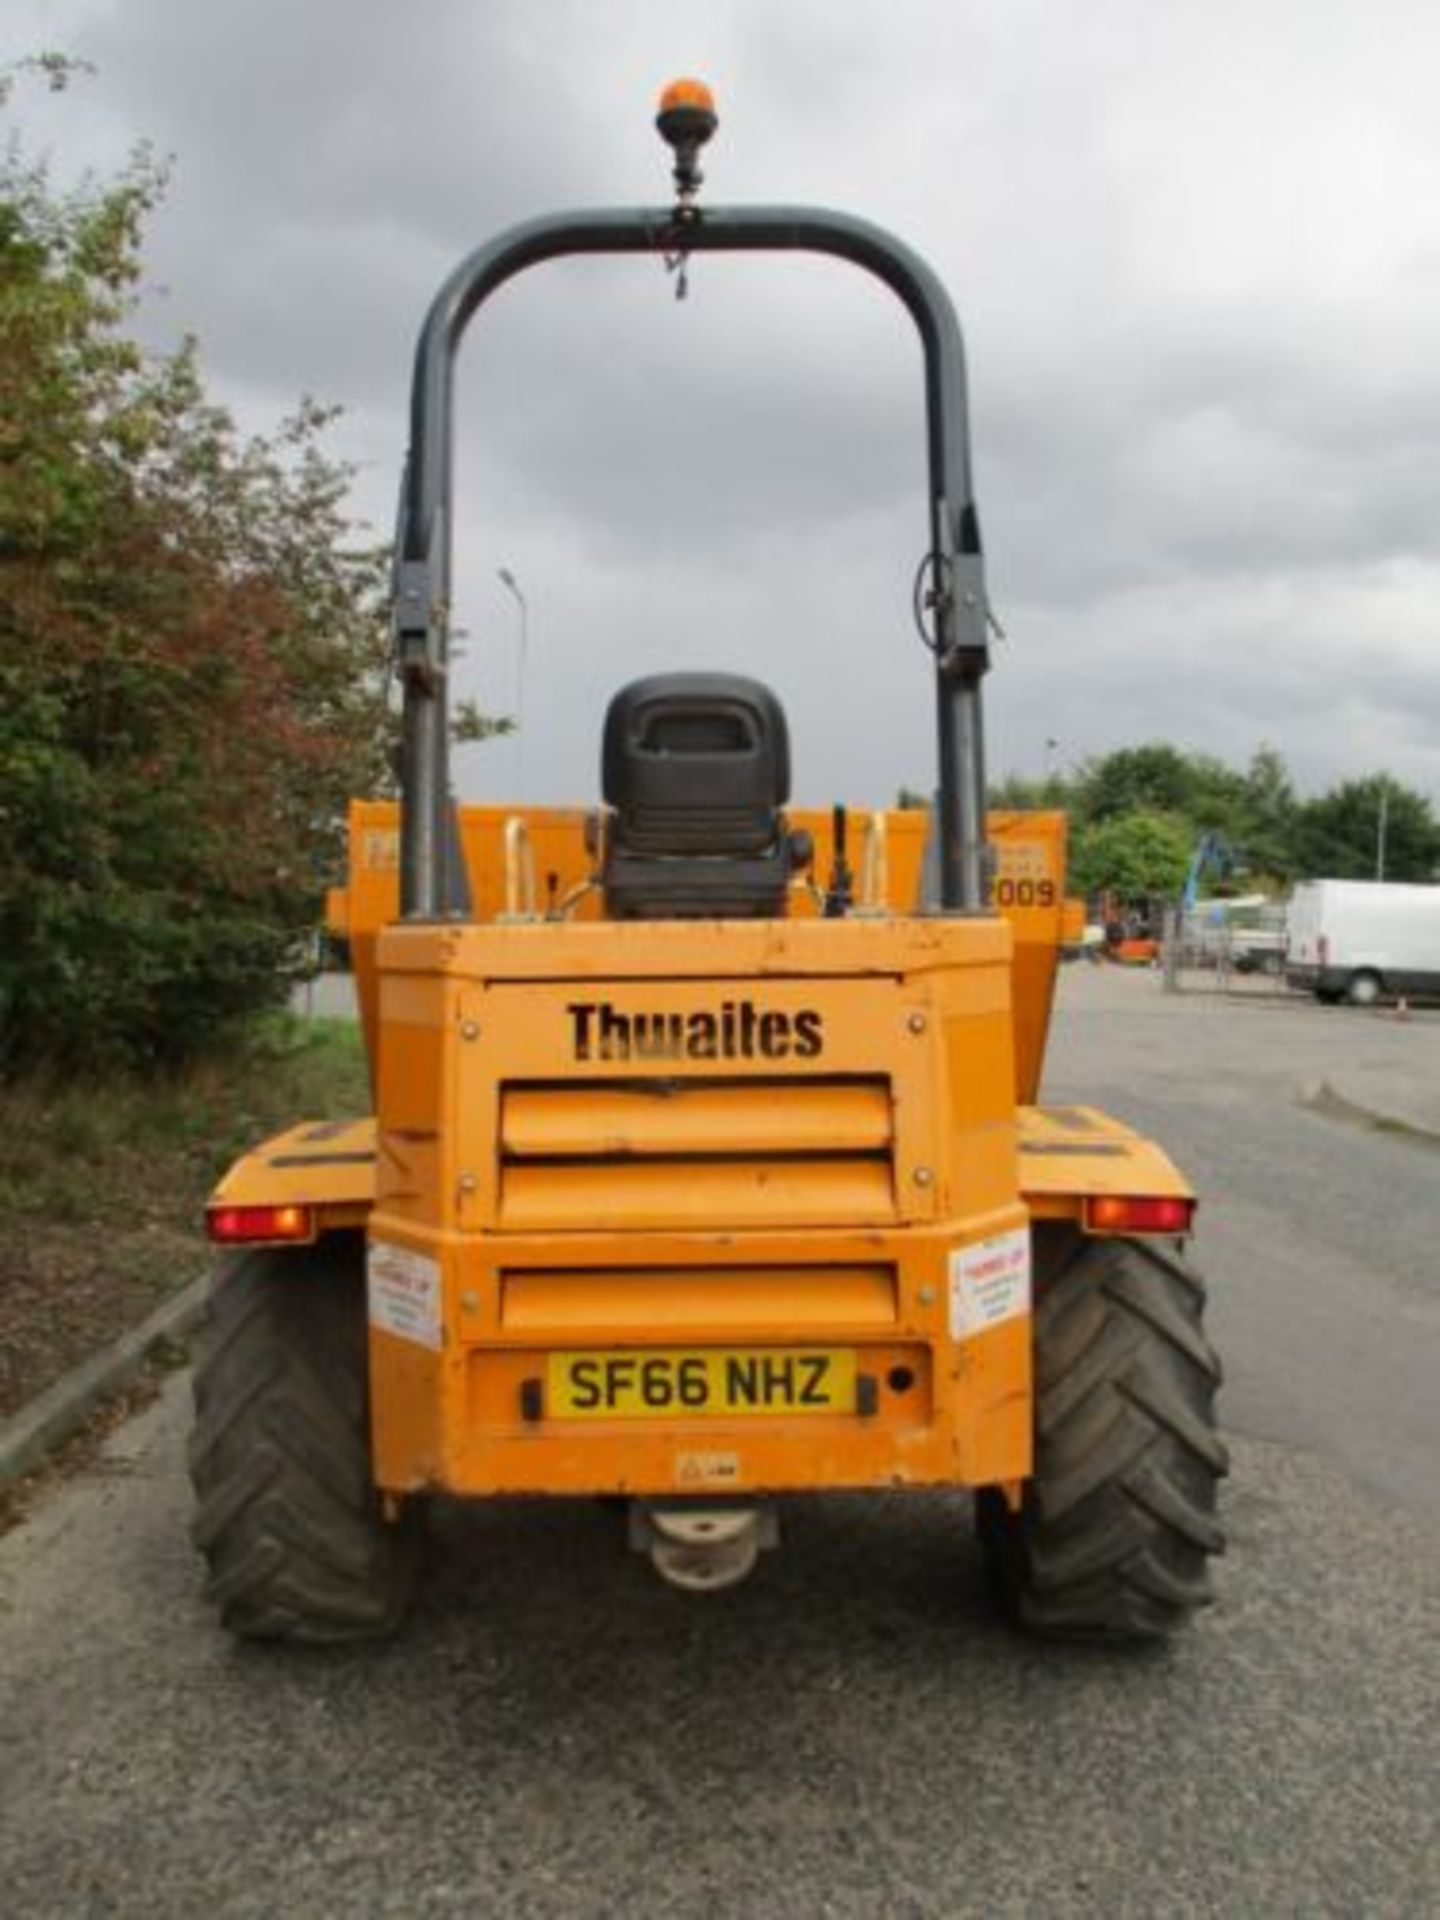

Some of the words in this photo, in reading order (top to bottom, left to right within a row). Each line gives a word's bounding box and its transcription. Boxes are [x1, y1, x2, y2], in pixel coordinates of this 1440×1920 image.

[567, 1002, 822, 1060] Thwaites
[570, 1358, 708, 1408] SF66
[726, 1356, 831, 1405] NHZ
